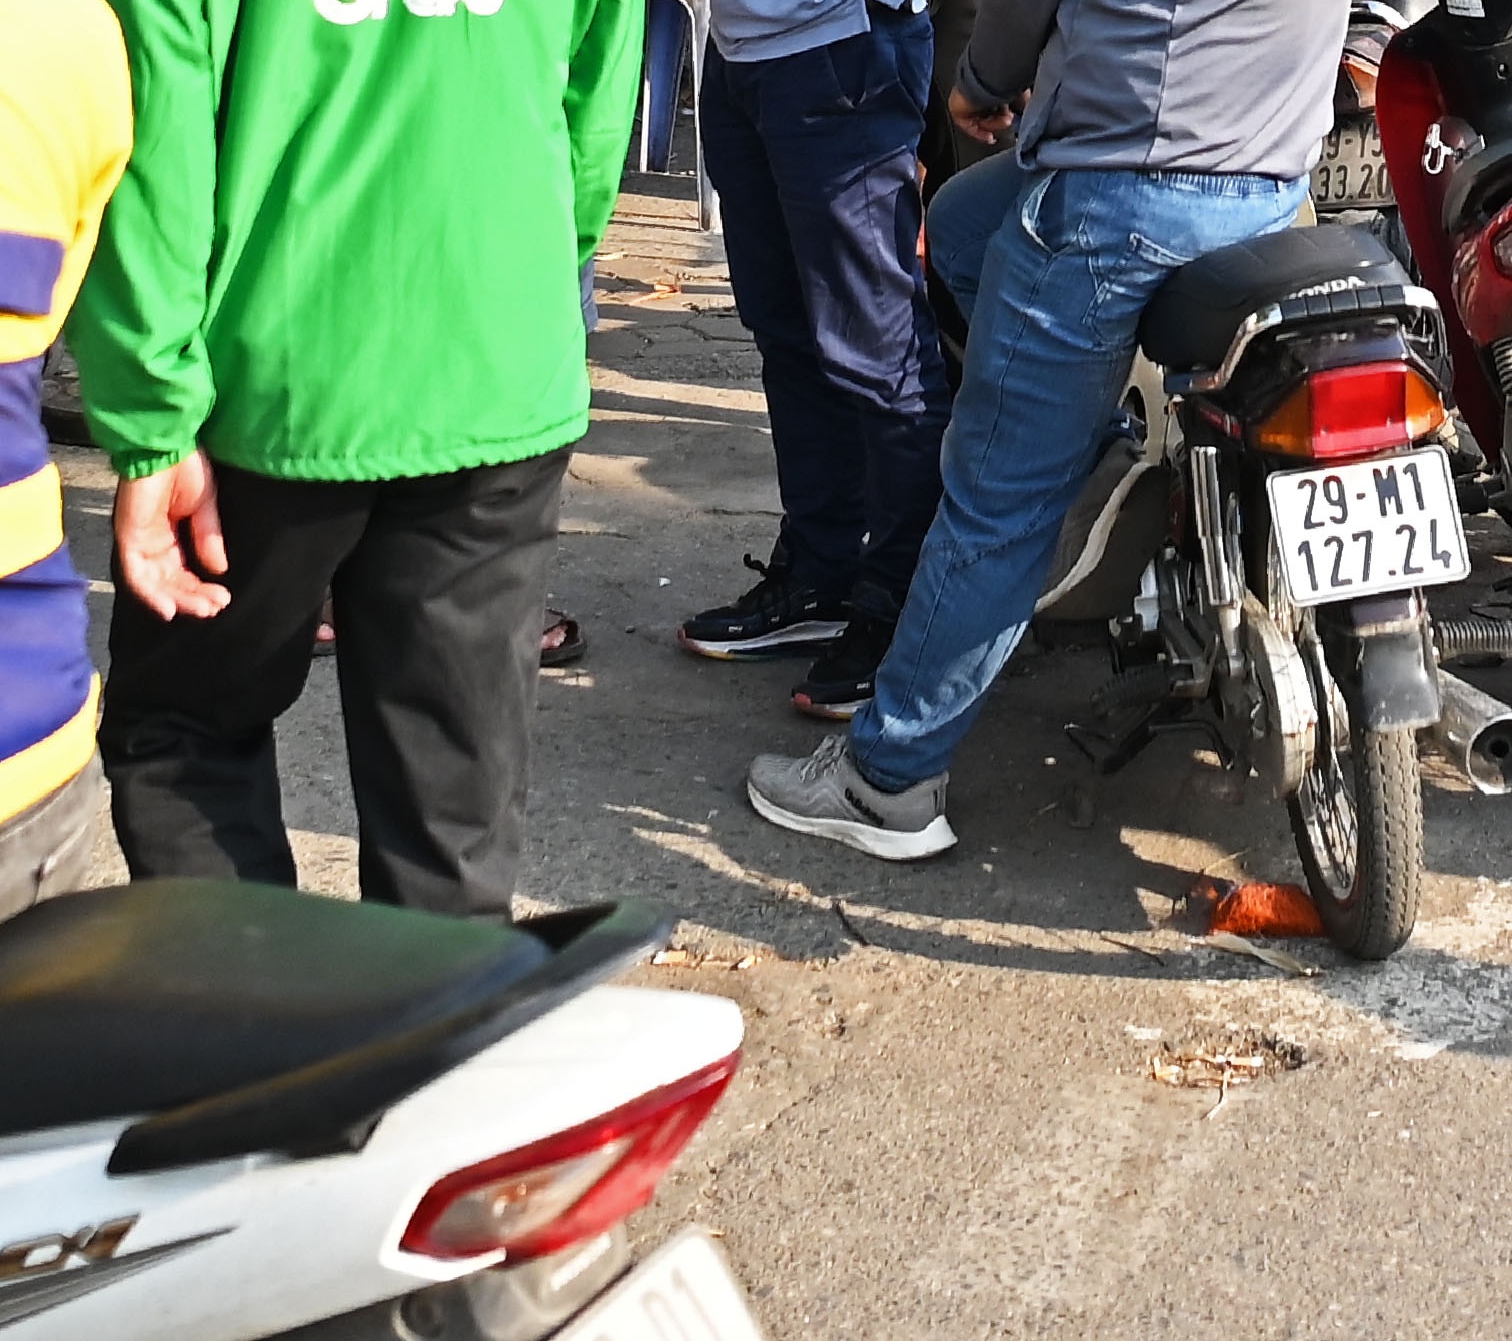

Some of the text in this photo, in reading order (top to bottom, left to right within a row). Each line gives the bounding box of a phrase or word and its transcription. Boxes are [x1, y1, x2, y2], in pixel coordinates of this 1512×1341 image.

[1316, 163, 1388, 202] 33.20
[1297, 462, 1426, 530] 29-M1
[1297, 518, 1452, 592] 127.24
